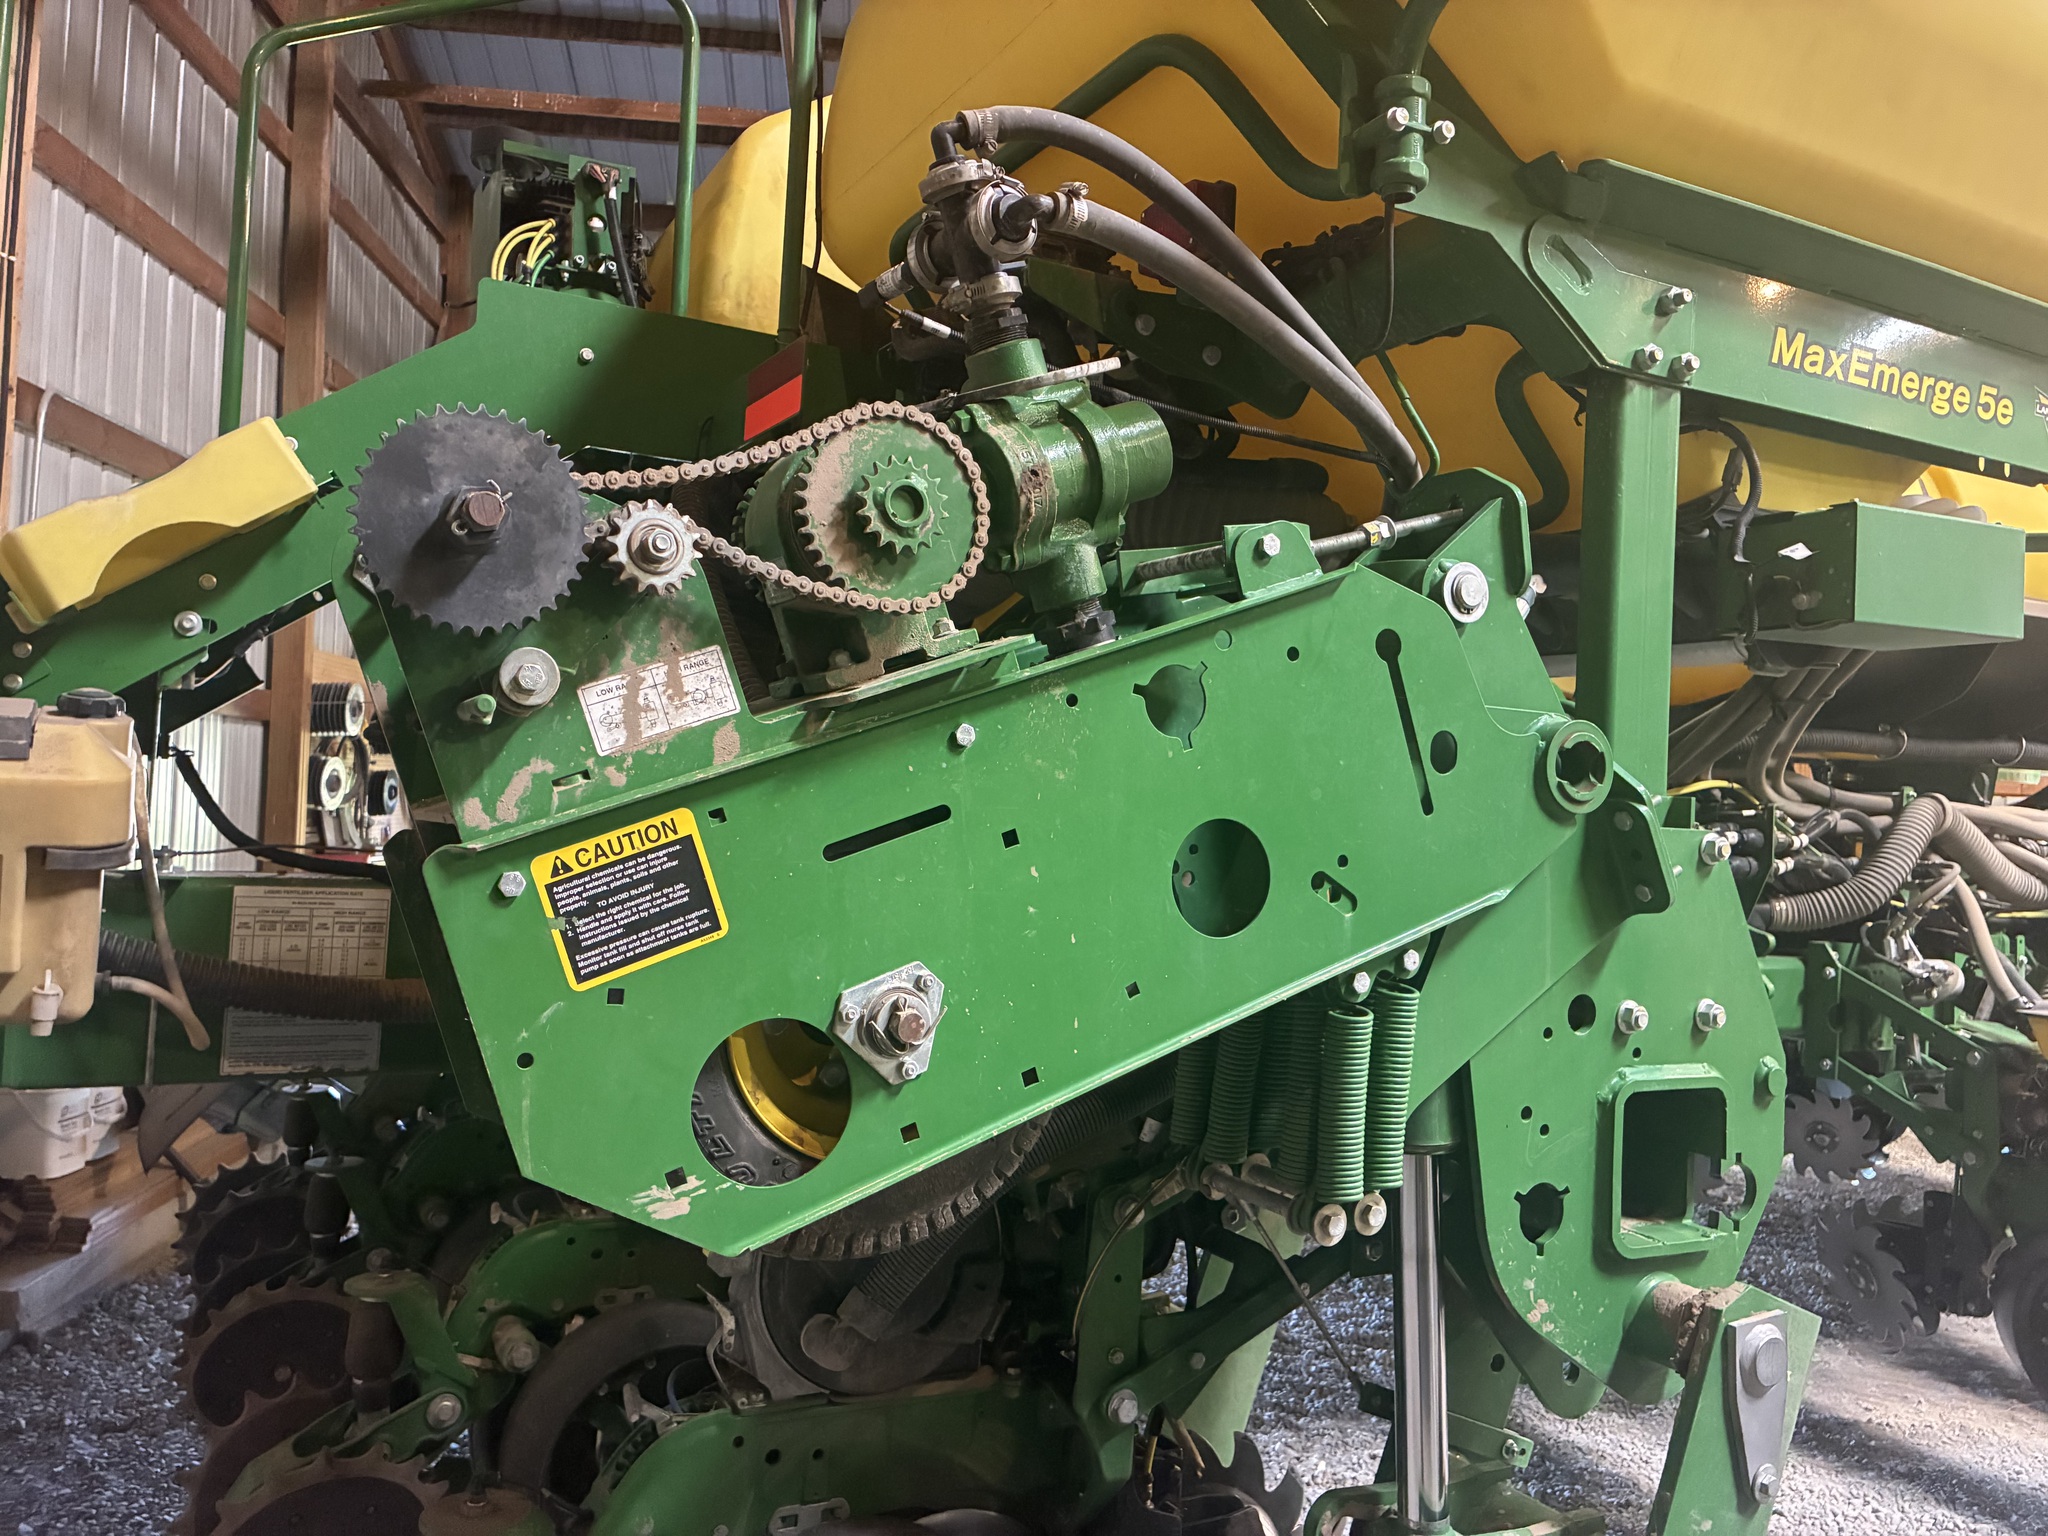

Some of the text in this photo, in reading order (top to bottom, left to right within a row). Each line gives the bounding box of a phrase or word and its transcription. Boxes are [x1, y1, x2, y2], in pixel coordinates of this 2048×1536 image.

[1771, 327, 2014, 426] MaxEmerge 5e
[683, 658, 710, 671] RANGE
[595, 686, 614, 698] LOW
[574, 817, 679, 868] CAUTION
[553, 875, 591, 893] Agricultural
[591, 864, 624, 879] chemicals
[624, 860, 637, 868] can
[647, 845, 682, 860] dangerous.
[554, 886, 584, 900] Improper
[585, 875, 615, 889] selection
[623, 868, 636, 876] use
[636, 863, 649, 871] can
[649, 856, 668, 867] injure
[557, 860, 679, 908] people, animals, plants, soils and other
[559, 900, 590, 915] property.
[576, 922, 600, 934] Handle
[600, 916, 613, 925] and
[614, 910, 632, 920] apply
[638, 902, 652, 911] with
[652, 897, 669, 906] care.
[669, 888, 690, 900] Follow
[578, 922, 618, 940] instructions
[618, 913, 640, 926] issued
[660, 895, 689, 910] chemical
[595, 911, 607, 919] the
[607, 905, 623, 915] right
[623, 894, 652, 909] chemical
[674, 883, 687, 891] job.
[596, 883, 654, 908] TO AVOID INJURY
[575, 908, 710, 961] Excessive pressure can cause tank rupture.
[578, 919, 700, 968] Monitor tank fill and shut off nurse tank
[580, 964, 599, 976] pump
[609, 954, 626, 964] soon
[635, 937, 670, 954] attachment
[670, 930, 688, 941] tanks
[688, 926, 699, 934] are
[699, 921, 712, 930] full.
[581, 928, 626, 947] manufacturer.
